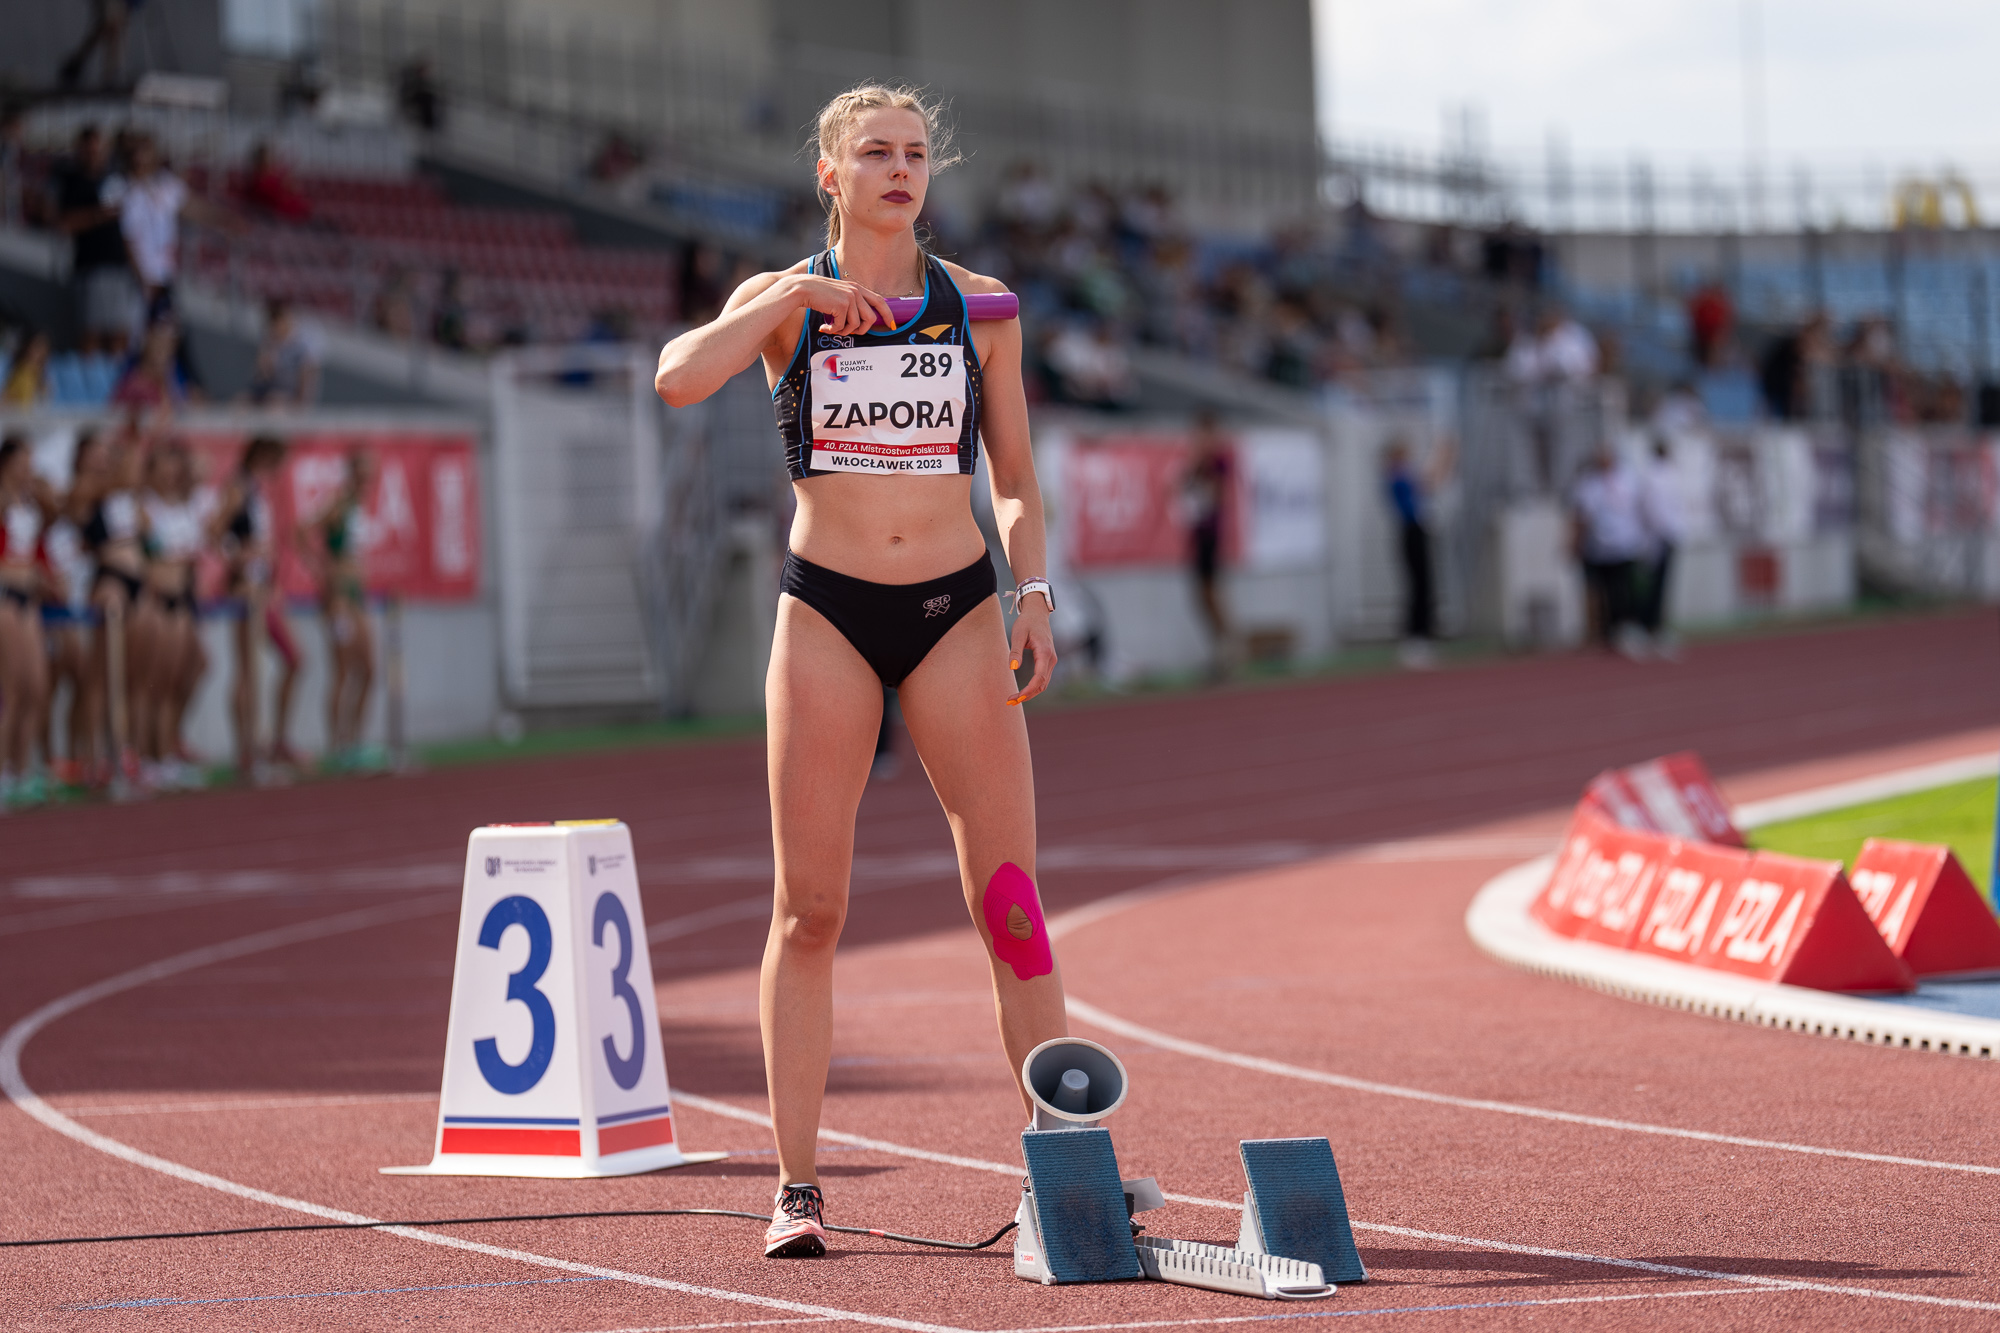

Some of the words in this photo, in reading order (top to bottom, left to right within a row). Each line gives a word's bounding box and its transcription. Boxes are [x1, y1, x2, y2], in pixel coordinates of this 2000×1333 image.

[840, 365, 874, 373] POMORZE
[900, 352, 953, 378] 289
[823, 400, 954, 429] ZAPORA
[823, 442, 837, 450] 40.
[838, 443, 859, 452] PZLA
[860, 444, 911, 455] Mistrzostwa
[912, 445, 935, 454] Polski
[936, 445, 951, 454] U23
[831, 455, 914, 470] WŁOCŁAWEK
[916, 459, 943, 469] 2023
[1639, 867, 1724, 956] PZLA
[1709, 878, 1806, 967] PZLA
[473, 894, 556, 1095] 3
[592, 890, 646, 1091] 3
